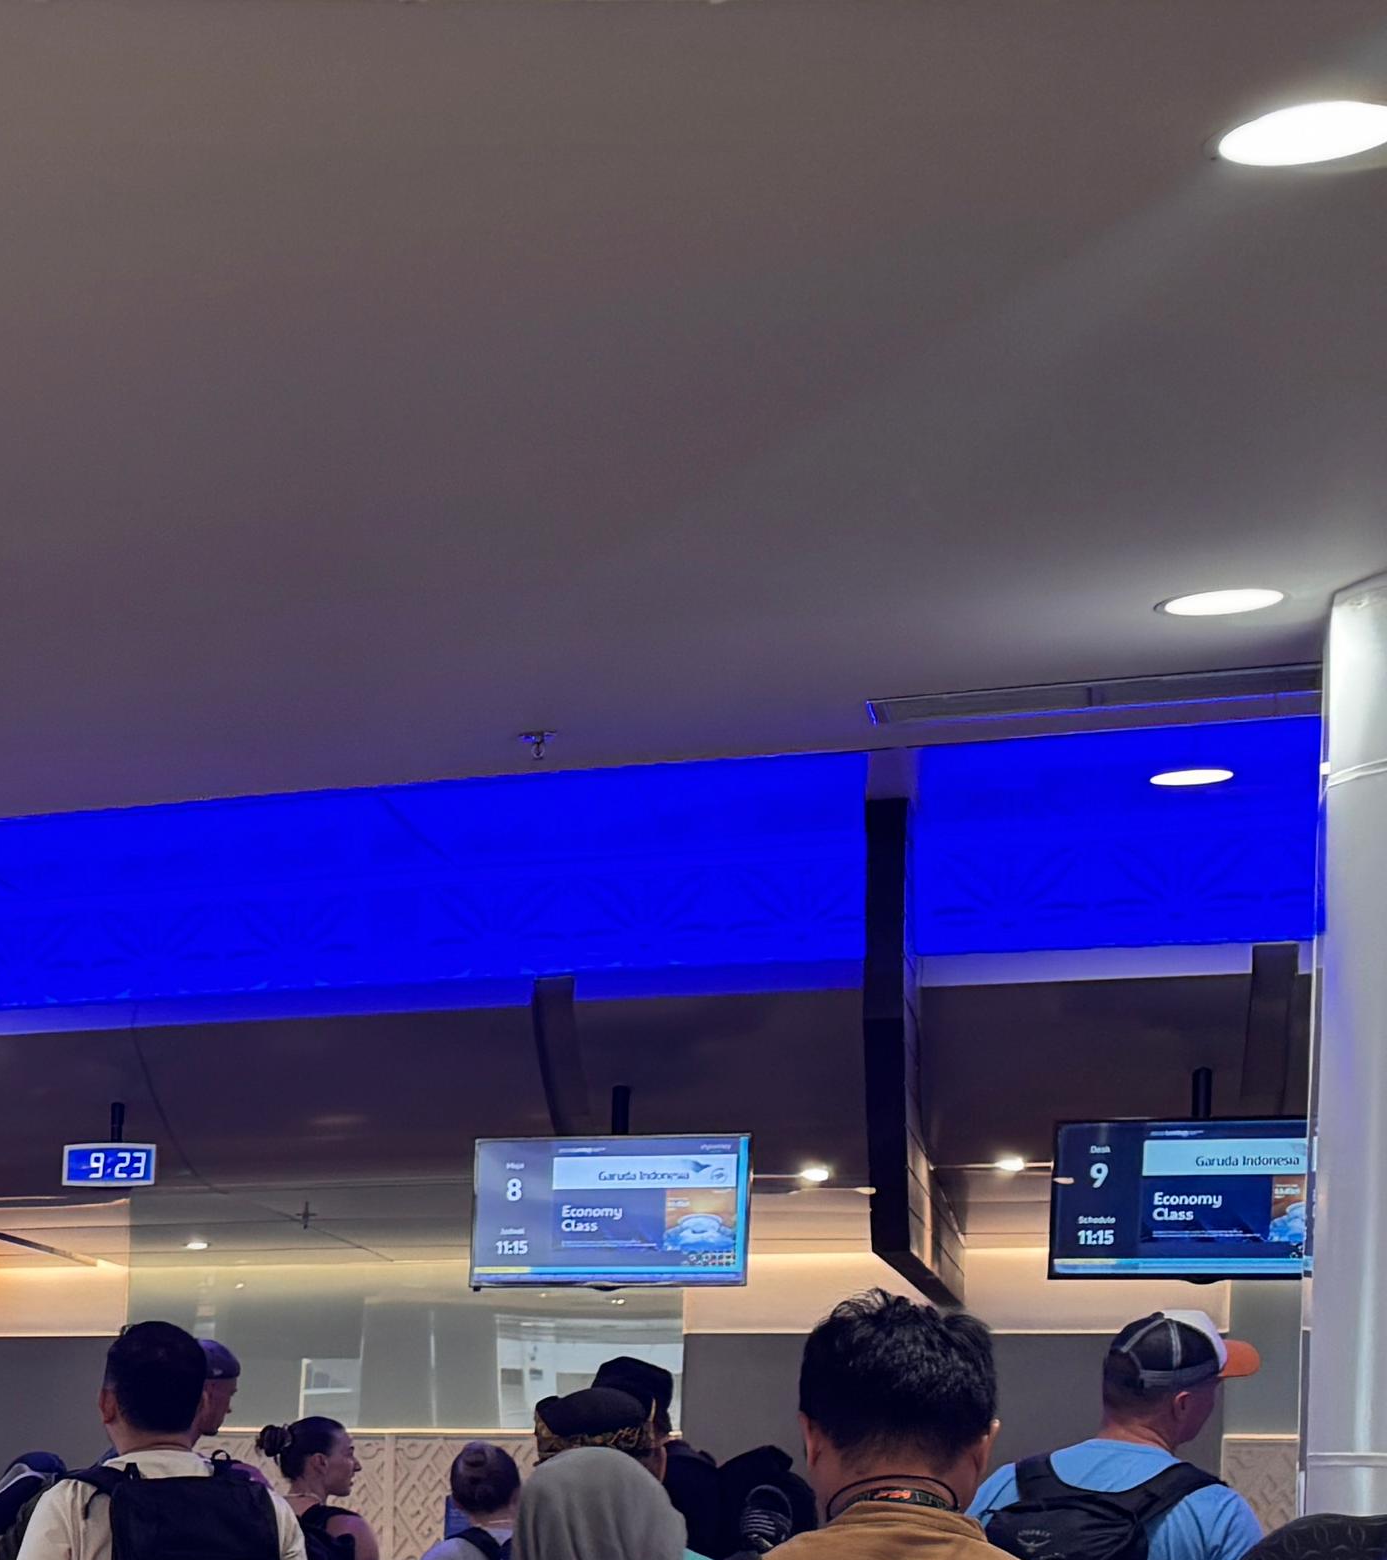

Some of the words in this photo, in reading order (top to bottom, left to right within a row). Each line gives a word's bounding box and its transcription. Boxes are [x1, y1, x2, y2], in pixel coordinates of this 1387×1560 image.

[1195, 1155, 1239, 1167] Garuda
[1242, 1154, 1300, 1166] Indonesia
[1089, 1162, 1109, 1189] 9
[506, 1178, 523, 1201] 8
[1153, 1191, 1223, 1209] Economy
[561, 1204, 623, 1220] Economy
[1152, 1207, 1194, 1221] Class
[561, 1219, 599, 1232] Class
[1077, 1229, 1114, 1245] 11:15
[495, 1239, 528, 1255] 11:15
